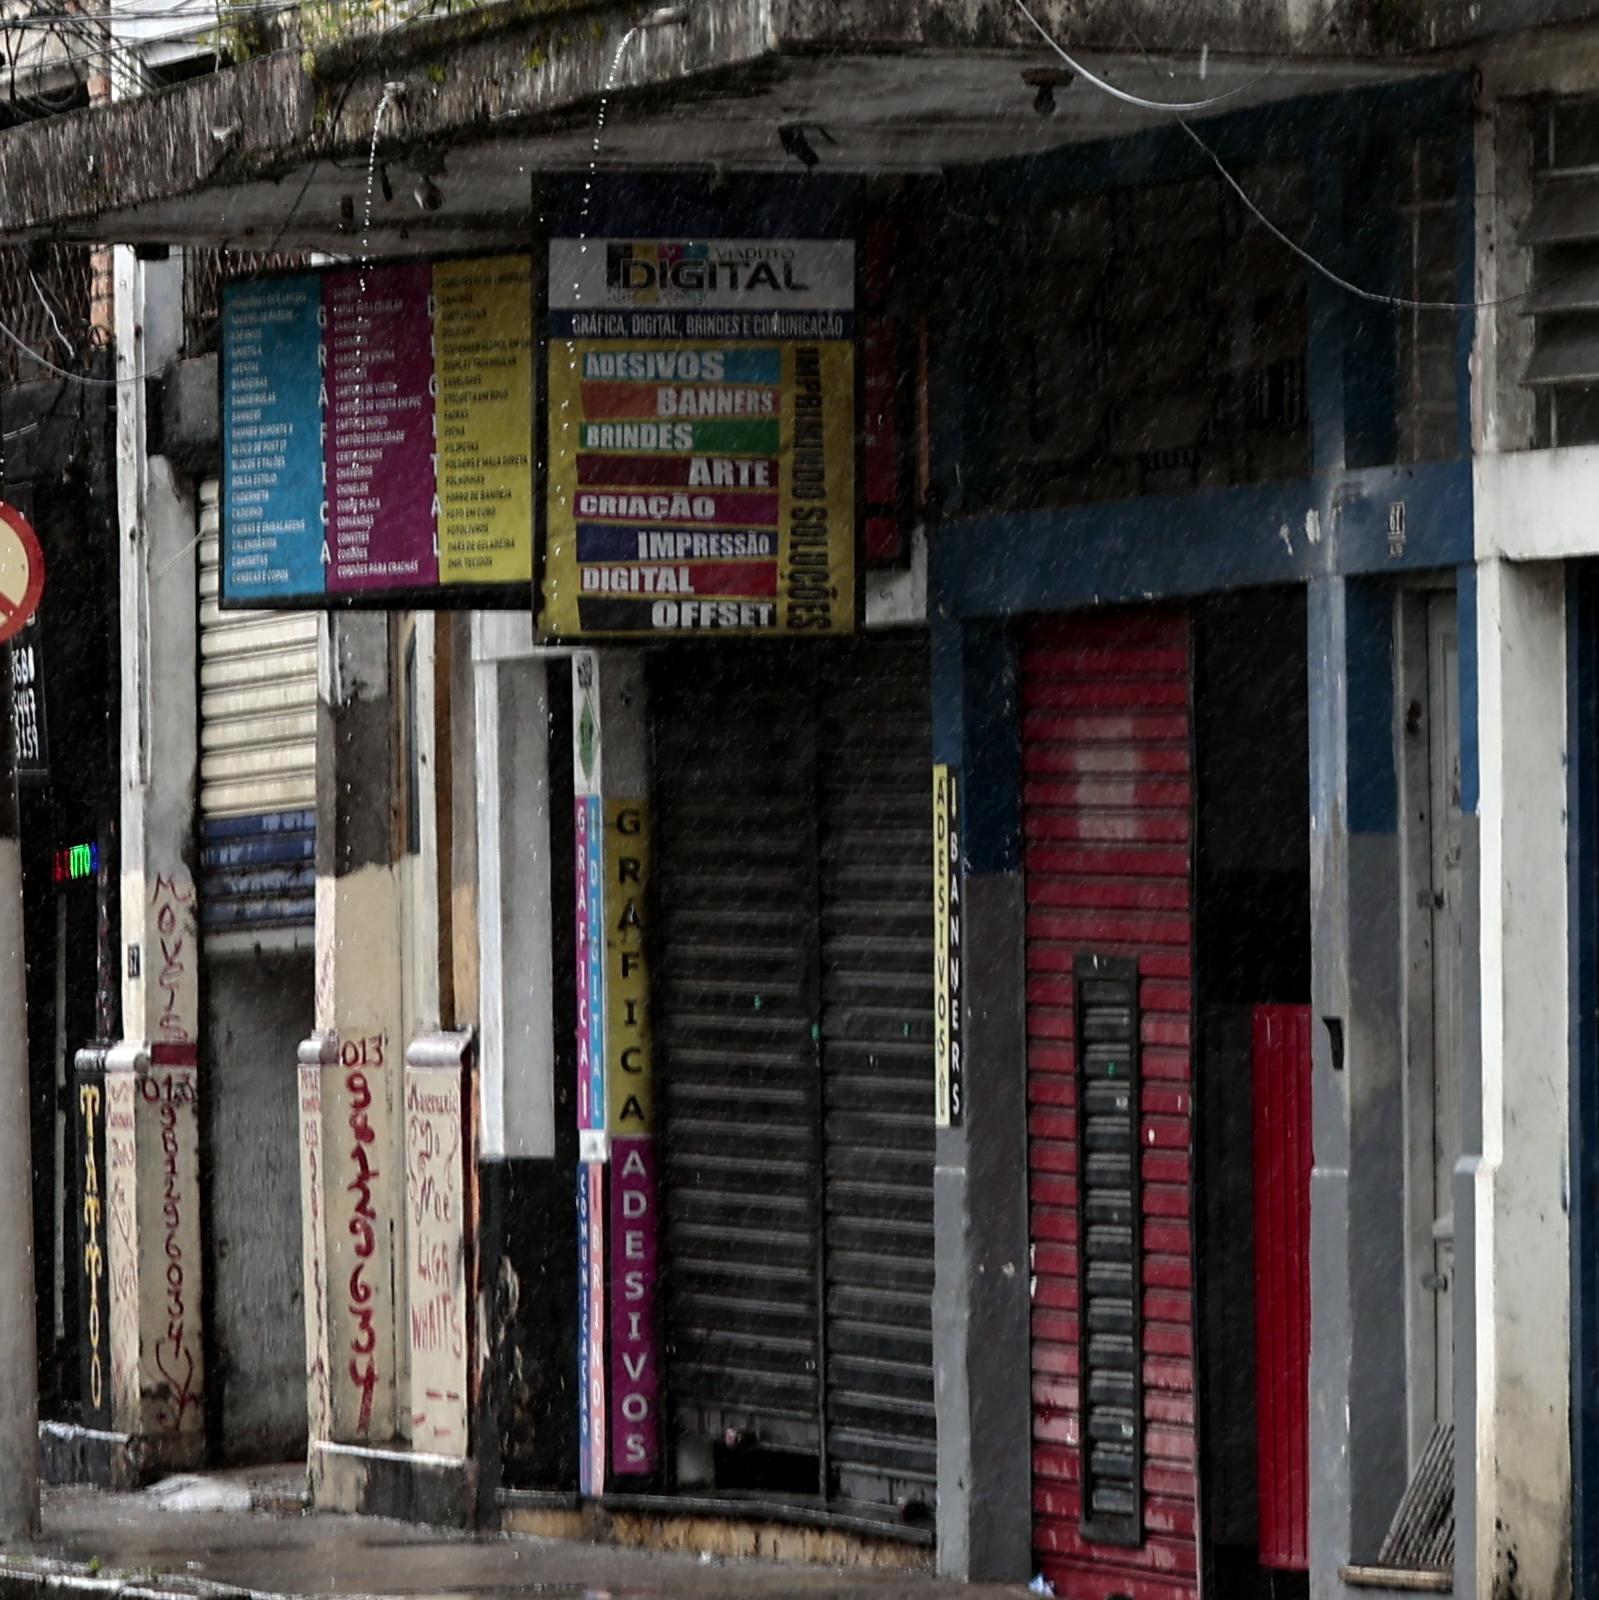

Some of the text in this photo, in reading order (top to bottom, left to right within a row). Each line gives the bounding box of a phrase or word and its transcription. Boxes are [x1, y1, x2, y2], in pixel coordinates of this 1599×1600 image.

[716, 246, 796, 260] VIADUTO
[621, 259, 808, 290] DIGITAL
[686, 315, 740, 335] BRINDES
[743, 316, 750, 334] E
[754, 312, 842, 337] COMUNICAÇÃO
[587, 351, 724, 380] ADESIVOS
[657, 387, 773, 416] BANNERS
[317, 304, 331, 565] GRÁFICA
[427, 293, 441, 558] DIGITAL
[587, 423, 694, 449] BRINDES
[688, 457, 769, 486] ARTE
[787, 347, 838, 629] IMPRIMINDO SOLUÇÕES
[579, 492, 715, 520] CRIAÇÃO
[638, 530, 769, 559] IMPRESSÃO
[232, 554, 268, 568] CAMISETAS
[583, 566, 694, 593] DIGITAL
[652, 600, 773, 628] OFFSET
[937, 781, 946, 1050] ADESIVOS
[577, 806, 589, 1066] GRÁFICA
[950, 831, 960, 1114] BANNERS
[590, 866, 600, 1117] DIGITAL
[341, 1037, 385, 1067] 013
[80, 1083, 101, 1409] TATTOO
[621, 1149, 649, 1463] ADESIVOS
[591, 1223, 601, 1490] BRINDES
